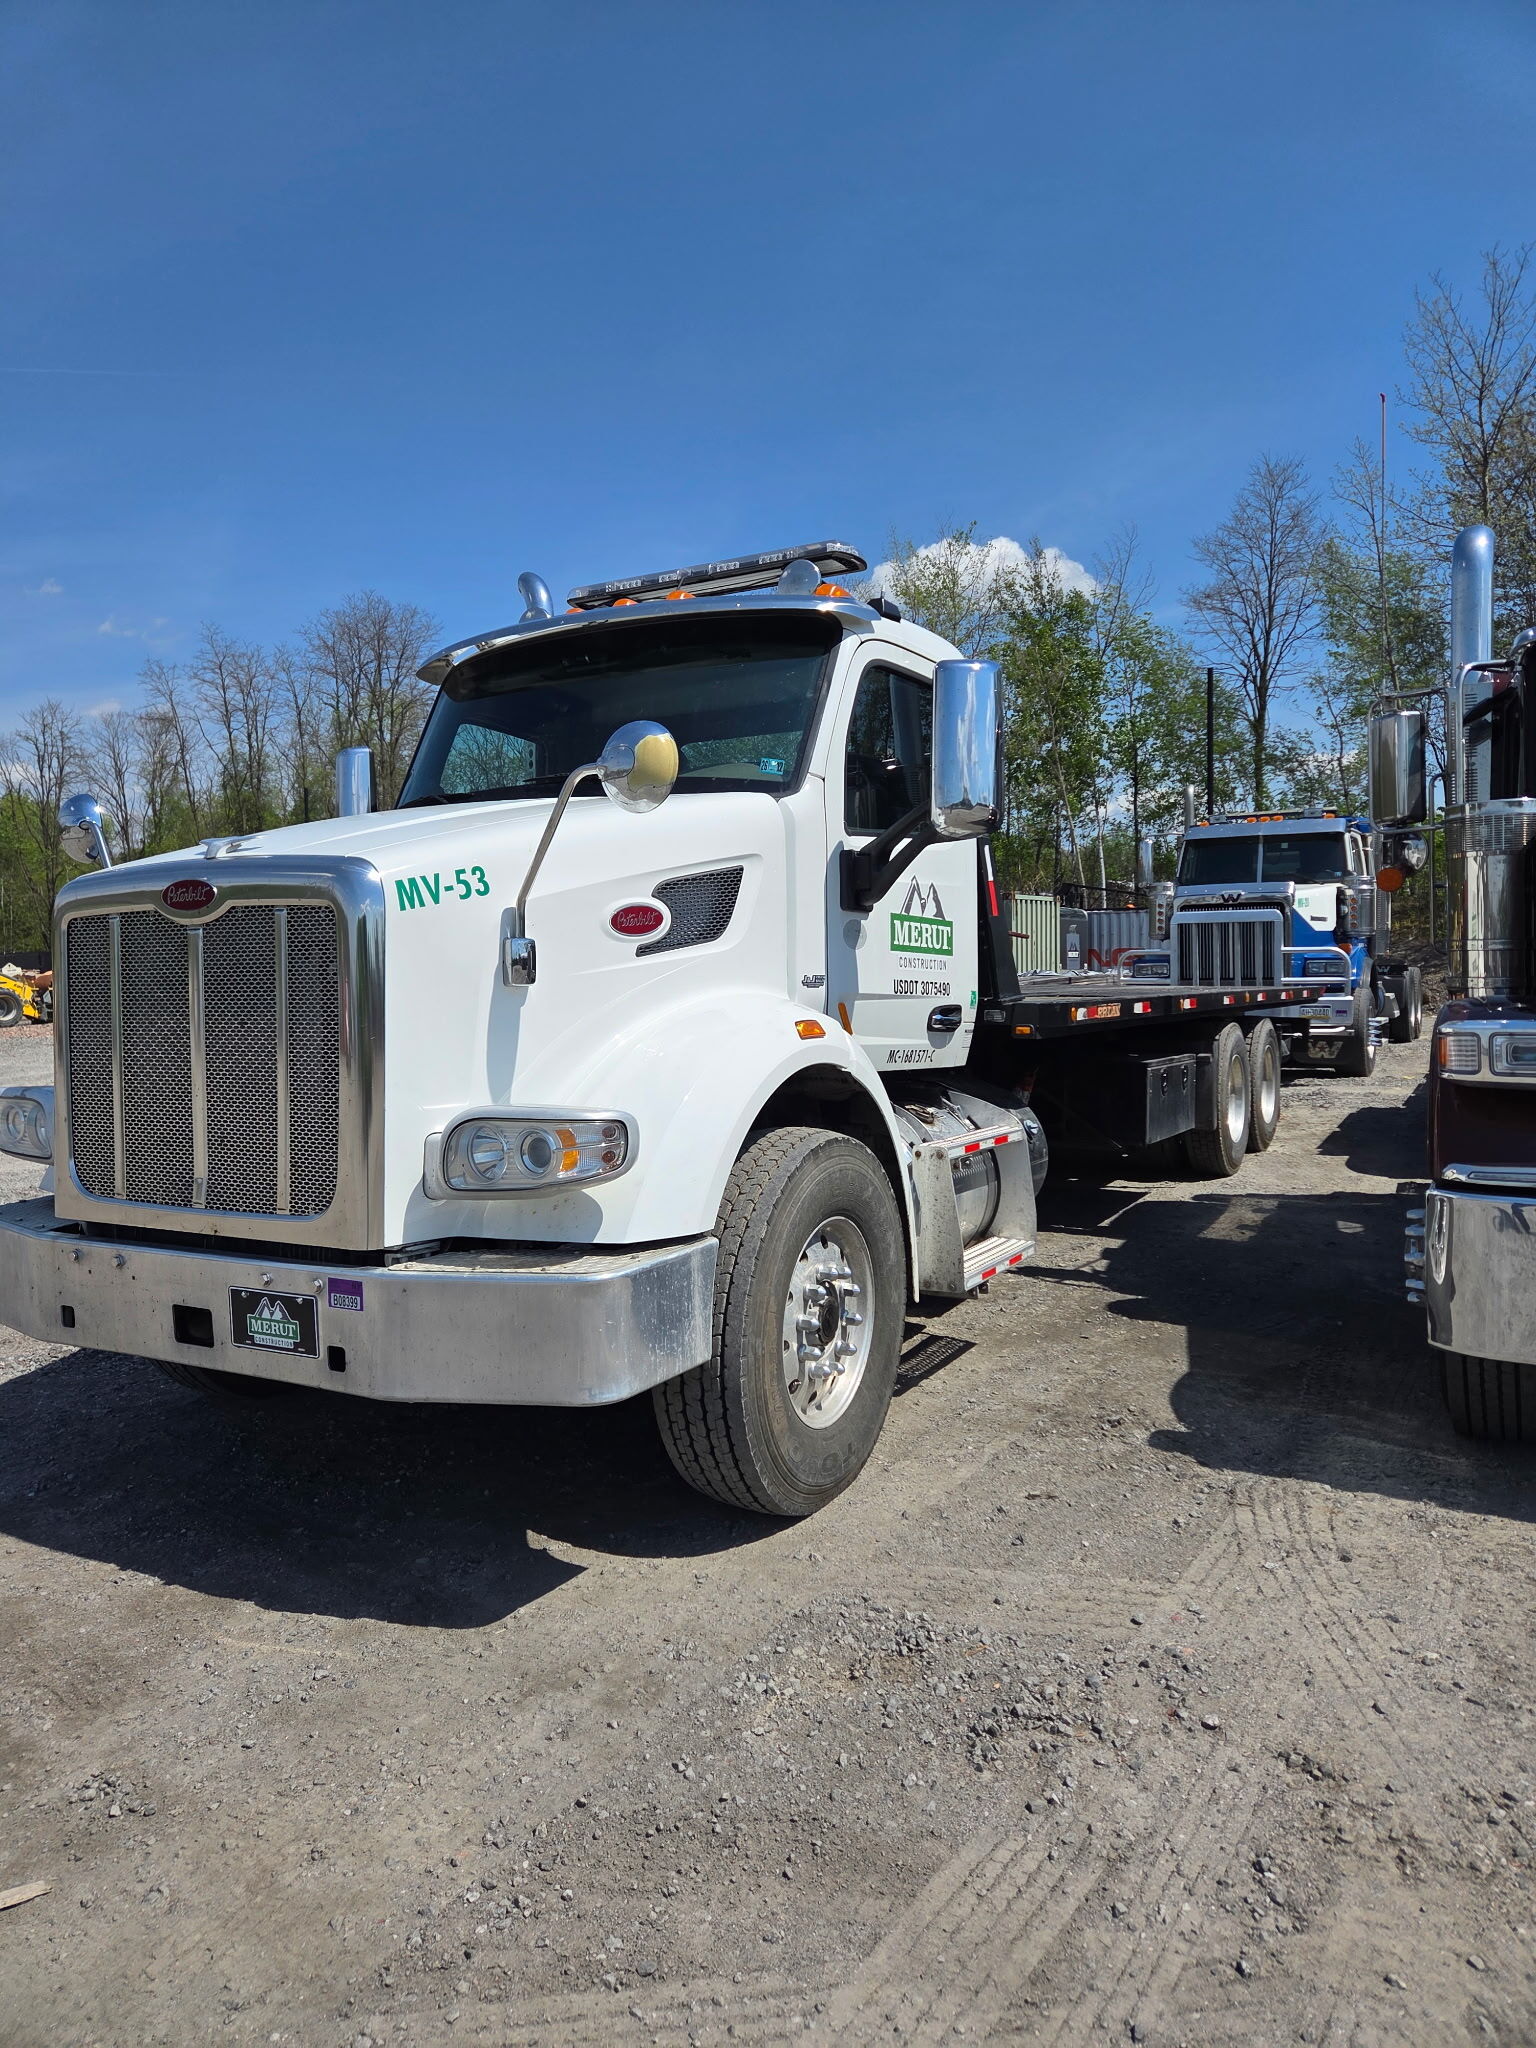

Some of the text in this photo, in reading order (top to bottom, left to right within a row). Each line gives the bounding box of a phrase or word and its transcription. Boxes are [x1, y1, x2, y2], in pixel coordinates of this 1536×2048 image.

[166, 884, 213, 904] Peterbilt
[395, 865, 491, 912] MV-53
[617, 911, 659, 929] Peterbilt
[893, 919, 951, 950] MERUT
[898, 956, 947, 971] CONSTRUCTION
[893, 979, 919, 995] USDOT
[886, 1049, 936, 1064] MC-1681571-C
[250, 1318, 296, 1337] MERUT
[254, 1335, 294, 1348] CONSTRUCTION
